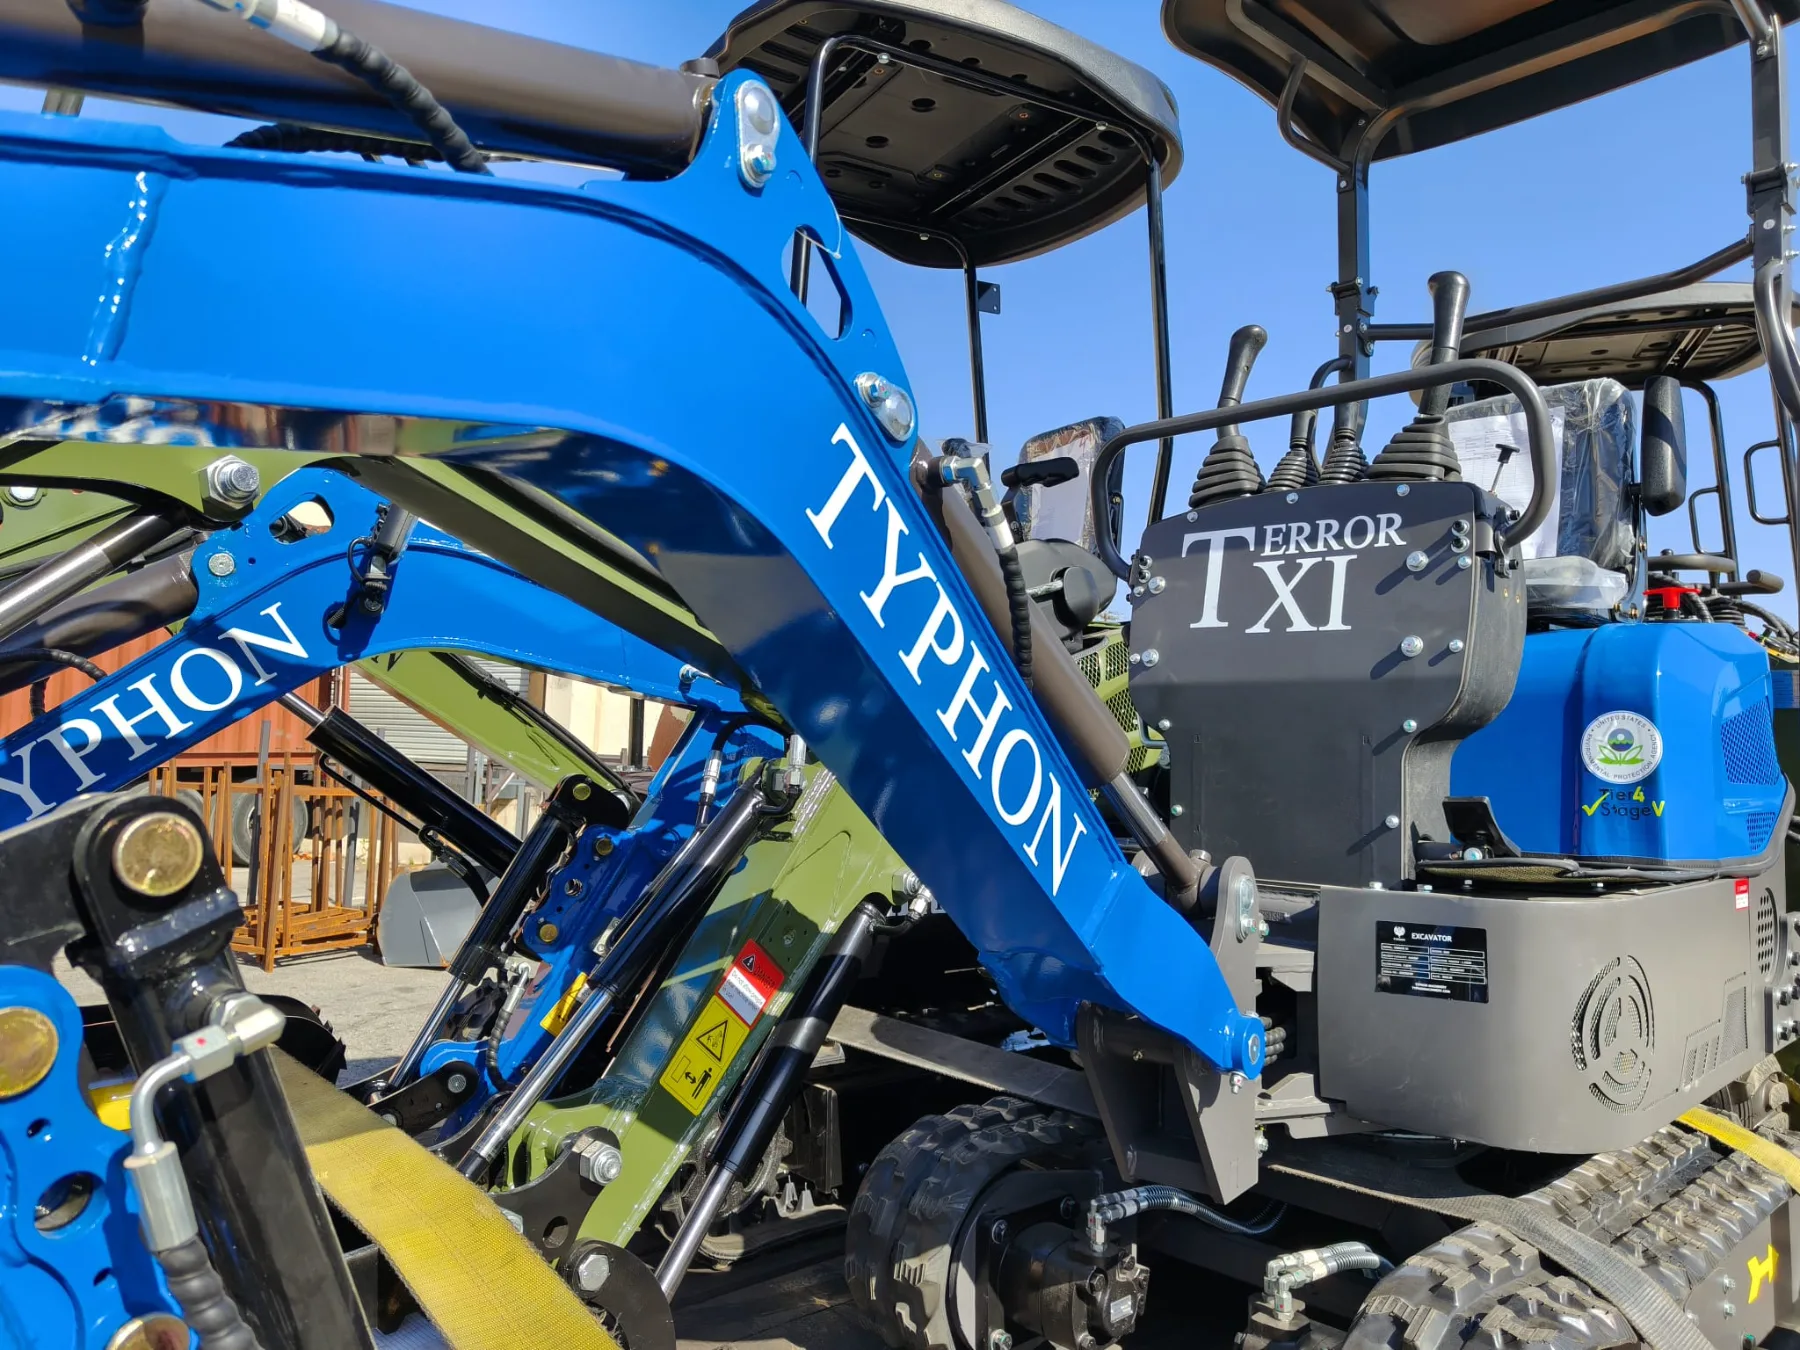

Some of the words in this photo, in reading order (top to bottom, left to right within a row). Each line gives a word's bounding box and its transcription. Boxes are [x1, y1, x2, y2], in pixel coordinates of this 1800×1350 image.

[1244, 554, 1358, 634] XI
[805, 423, 1088, 897] TYPHON
[1595, 714, 1619, 729] UNITED
[1621, 714, 1647, 729] STATES
[1584, 733, 1610, 778] ENVIRONMENTAL
[1613, 761, 1653, 780] PROTECTION
[1411, 932, 1453, 943] EXCAVATOR
